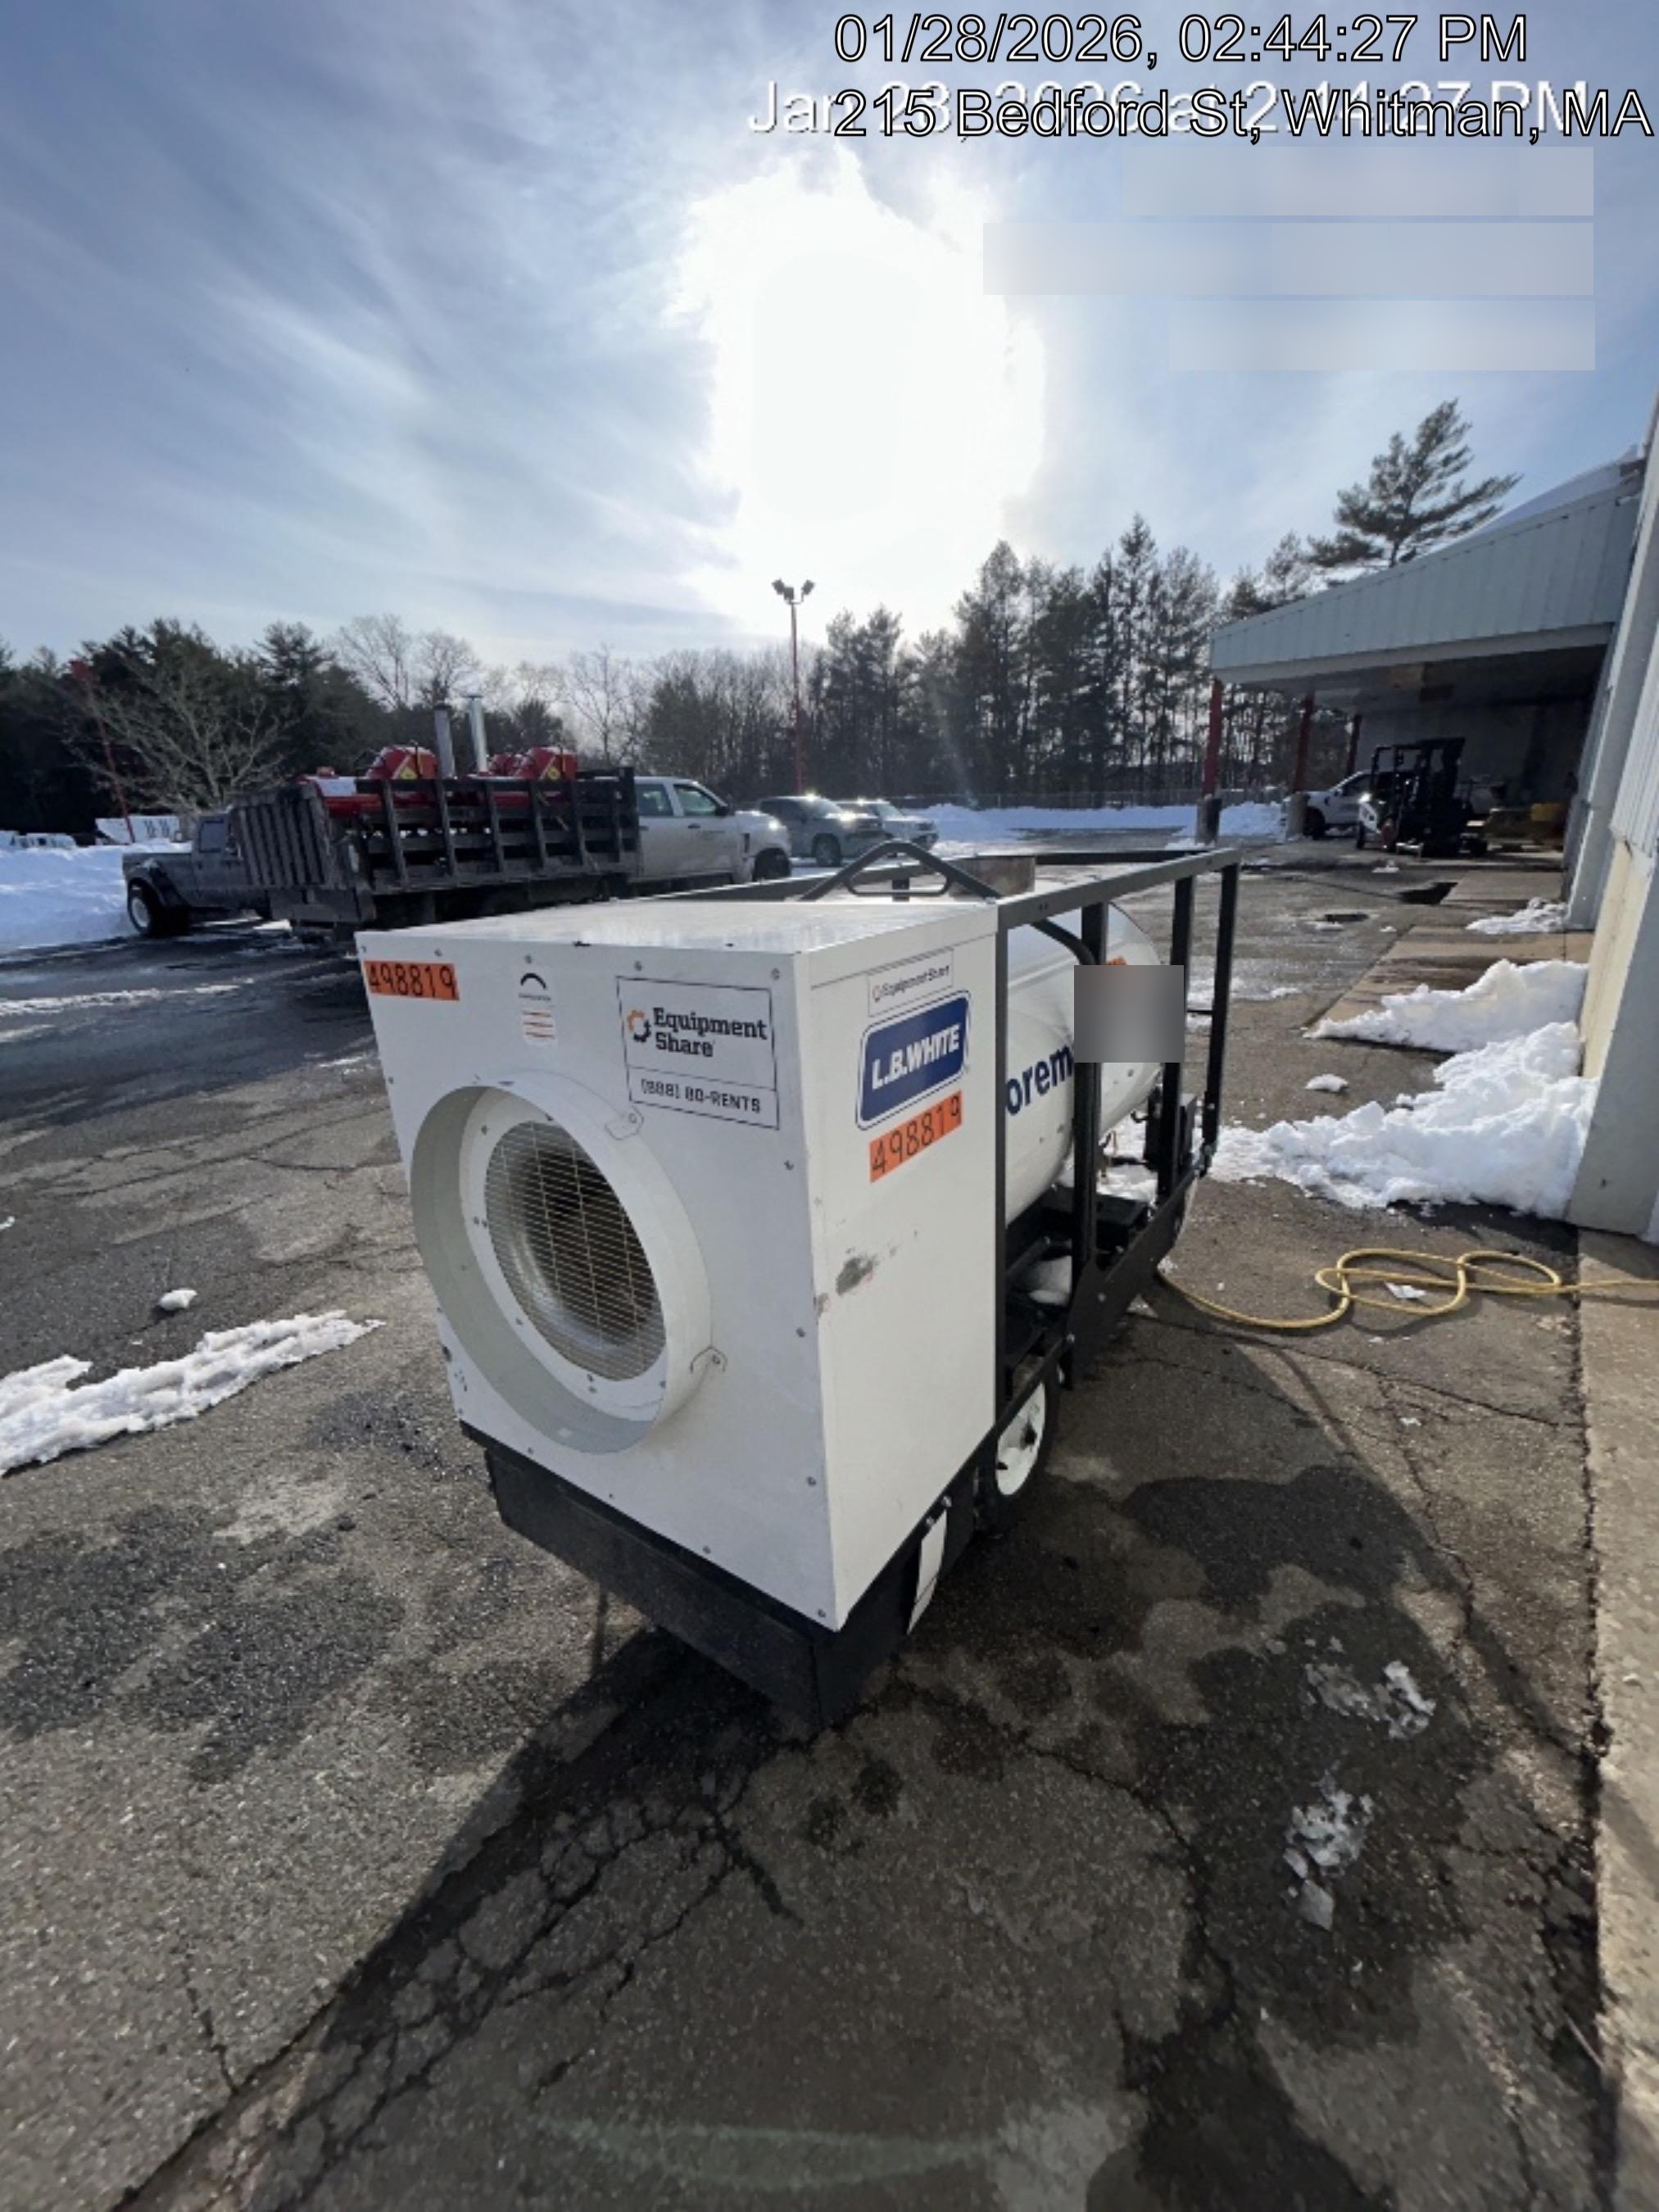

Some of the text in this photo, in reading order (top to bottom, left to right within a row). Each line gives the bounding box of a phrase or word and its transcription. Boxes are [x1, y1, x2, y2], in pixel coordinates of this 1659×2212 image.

[369, 963, 456, 999] 498819
[653, 1007, 768, 1040] Equipment
[655, 1031, 714, 1057] Share
[641, 1078, 761, 1114] (888) 80-RENTS
[1006, 1045, 1074, 1116] orem
